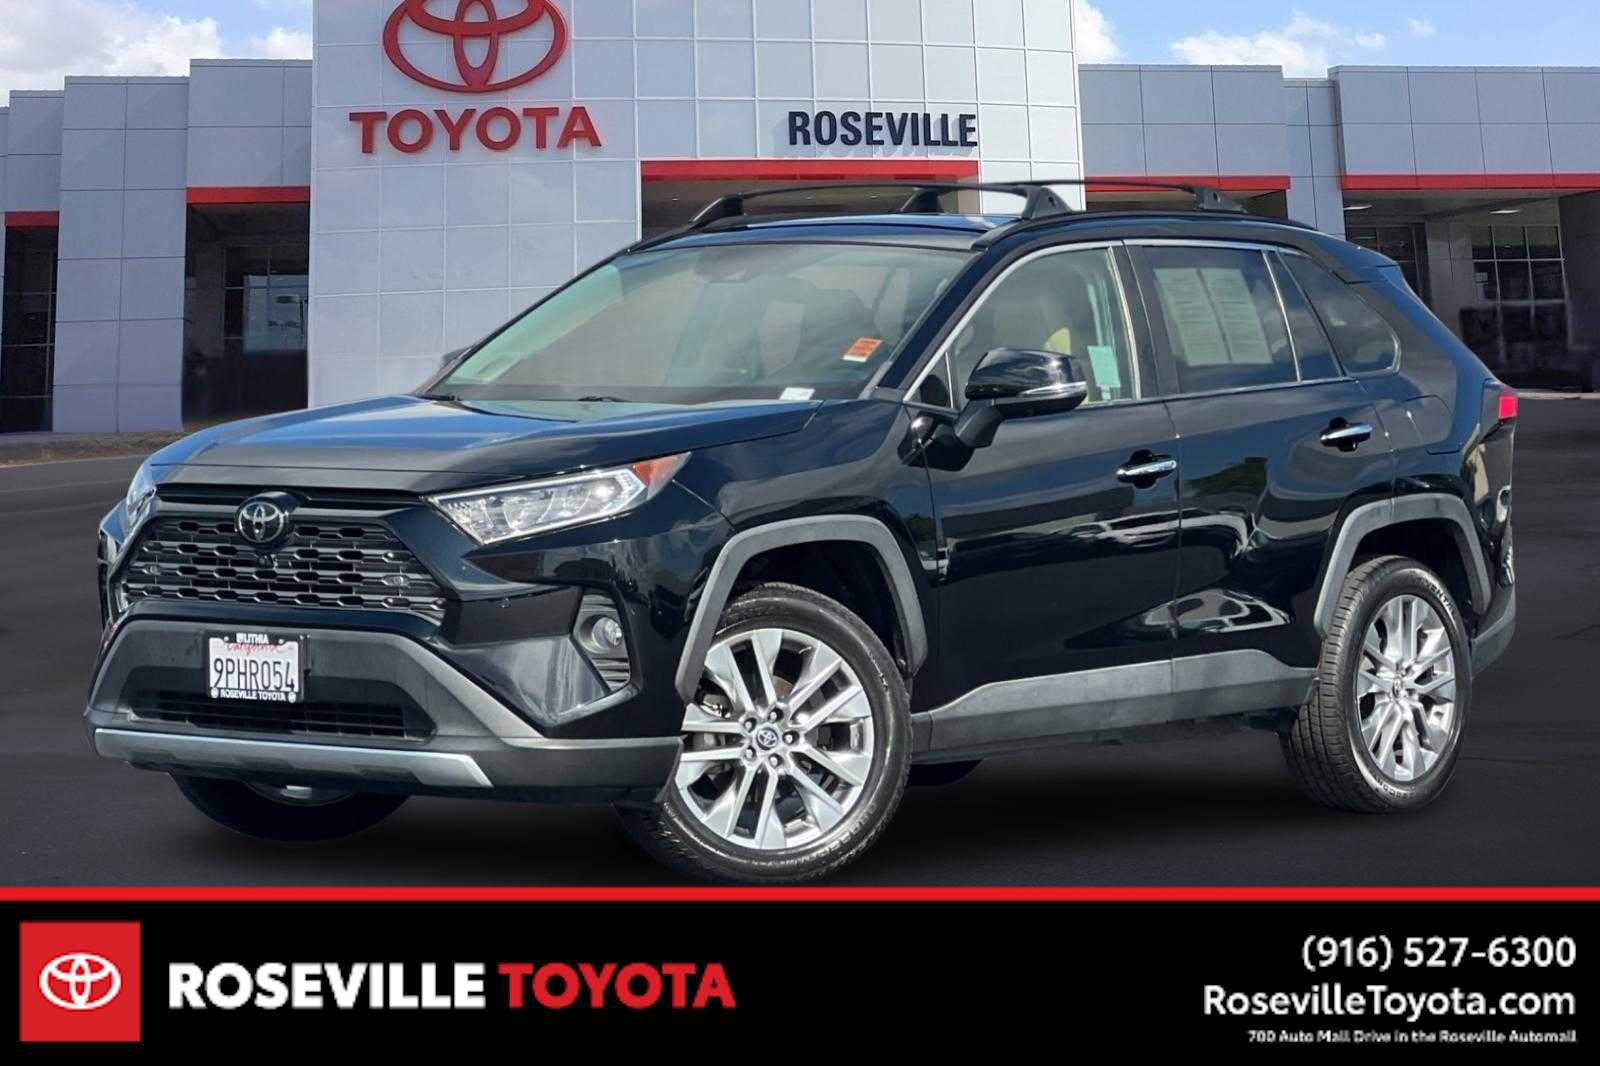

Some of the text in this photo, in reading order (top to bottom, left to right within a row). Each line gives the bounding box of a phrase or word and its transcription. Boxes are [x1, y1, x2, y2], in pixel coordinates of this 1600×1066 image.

[349, 106, 602, 154] TOYOTA
[788, 111, 978, 147] ROSEVILLE
[213, 657, 295, 692] 9PHR054
[220, 688, 287, 701] ROSEVILLE TOYOTA
